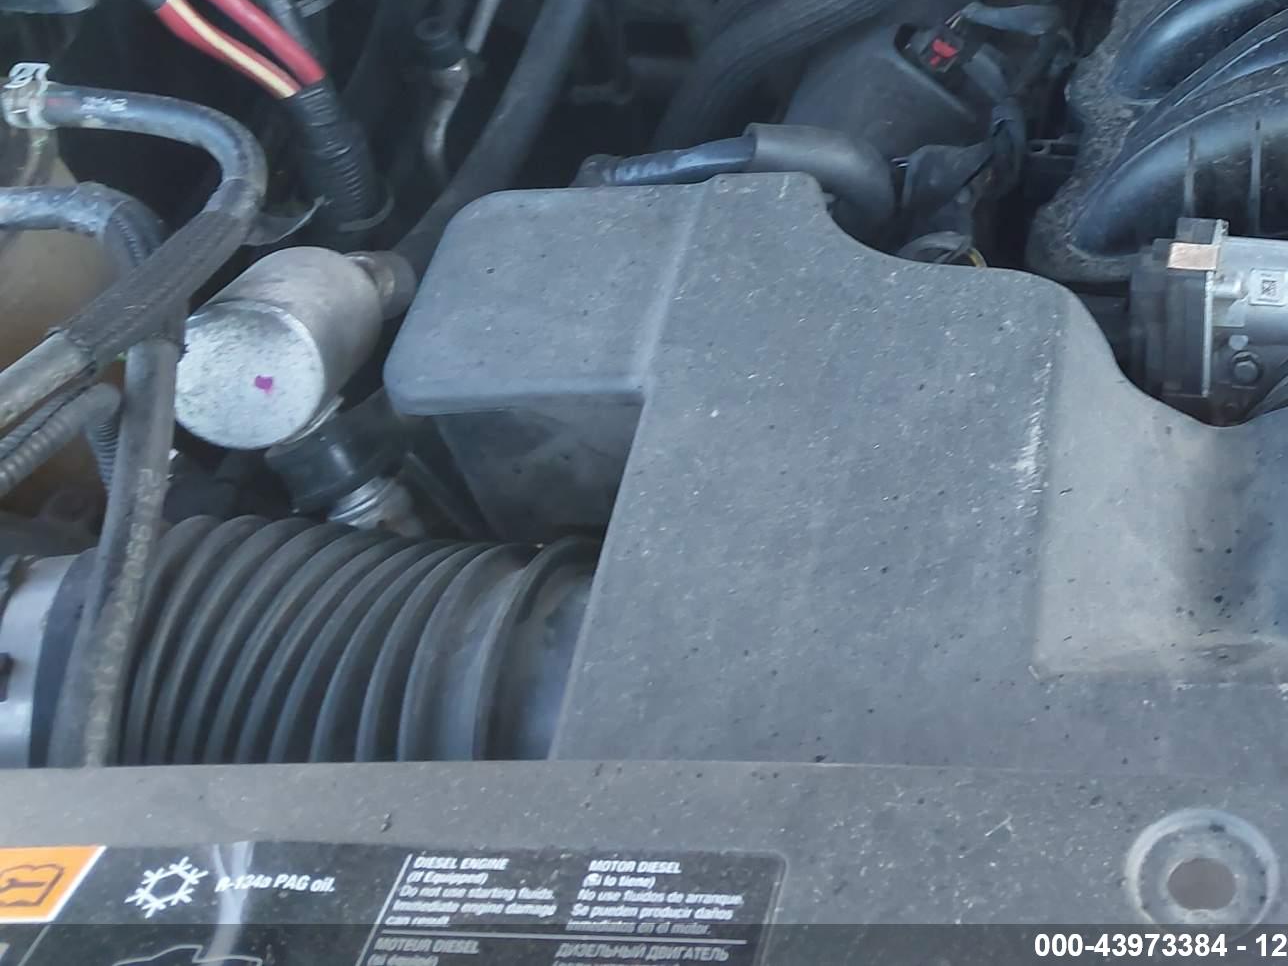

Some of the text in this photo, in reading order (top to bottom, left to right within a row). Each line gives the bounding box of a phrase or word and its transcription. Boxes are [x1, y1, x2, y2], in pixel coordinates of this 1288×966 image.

[413, 856, 511, 871] DIESEL ENGINE
[588, 860, 683, 874] MOTOR DIESEL
[214, 874, 336, 893] R-134a PAG oil.
[423, 870, 489, 886] Equipped)
[618, 875, 656, 889] tiene)
[399, 884, 419, 898] Do
[418, 886, 442, 898] not
[441, 888, 467, 898] use
[467, 888, 517, 902] starting
[577, 889, 596, 901] No
[597, 891, 622, 902] use
[621, 890, 666, 903] fluidos
[666, 891, 685, 903] de
[392, 899, 558, 918] Immediate engine damage
[571, 903, 734, 920] Se pueden producir daños
[385, 916, 411, 926] can
[374, 937, 480, 955] MOTEUR DIESEL
[554, 942, 730, 962] ДИЗЕЛЬНЫЙ ДВИГАТЕЛЬ
